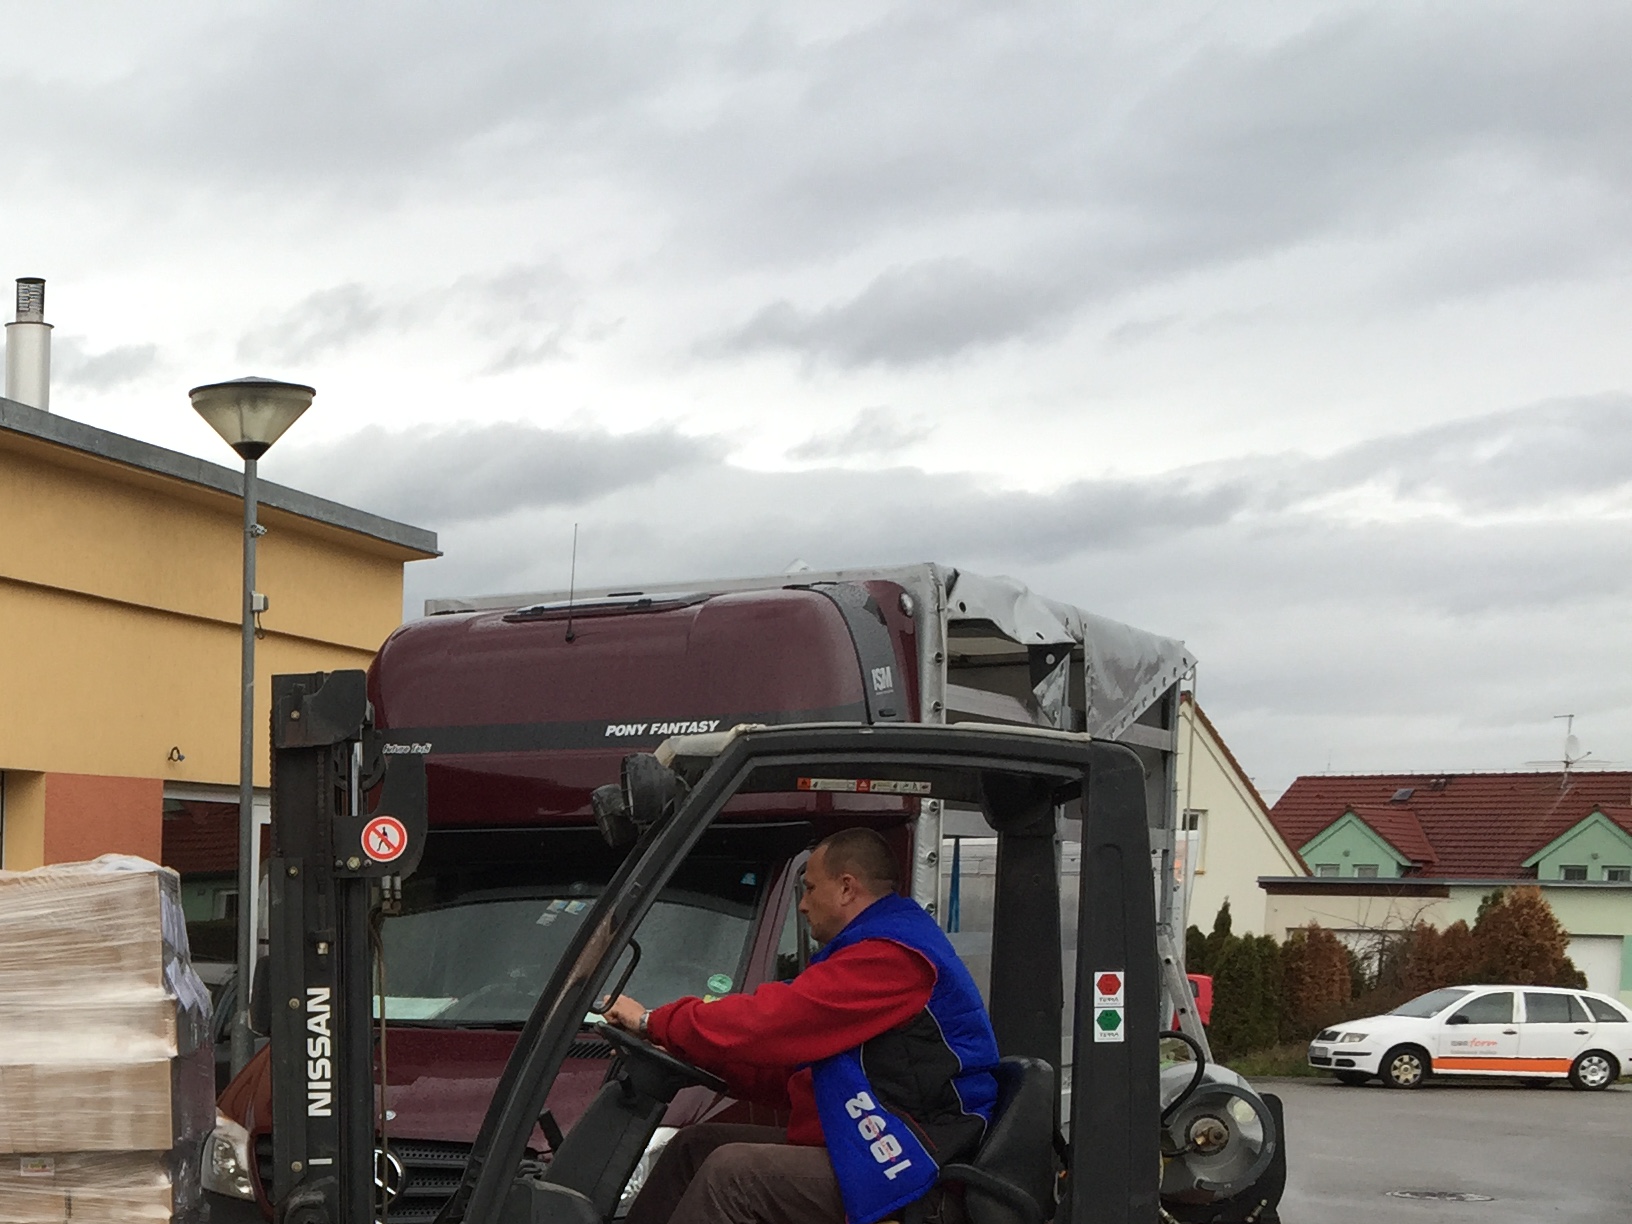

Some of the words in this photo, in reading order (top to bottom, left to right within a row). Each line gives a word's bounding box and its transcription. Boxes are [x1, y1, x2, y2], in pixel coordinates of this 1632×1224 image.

[605, 723, 647, 737] PONY
[649, 720, 720, 735] FANTASY
[306, 987, 332, 1117] NISSAN
